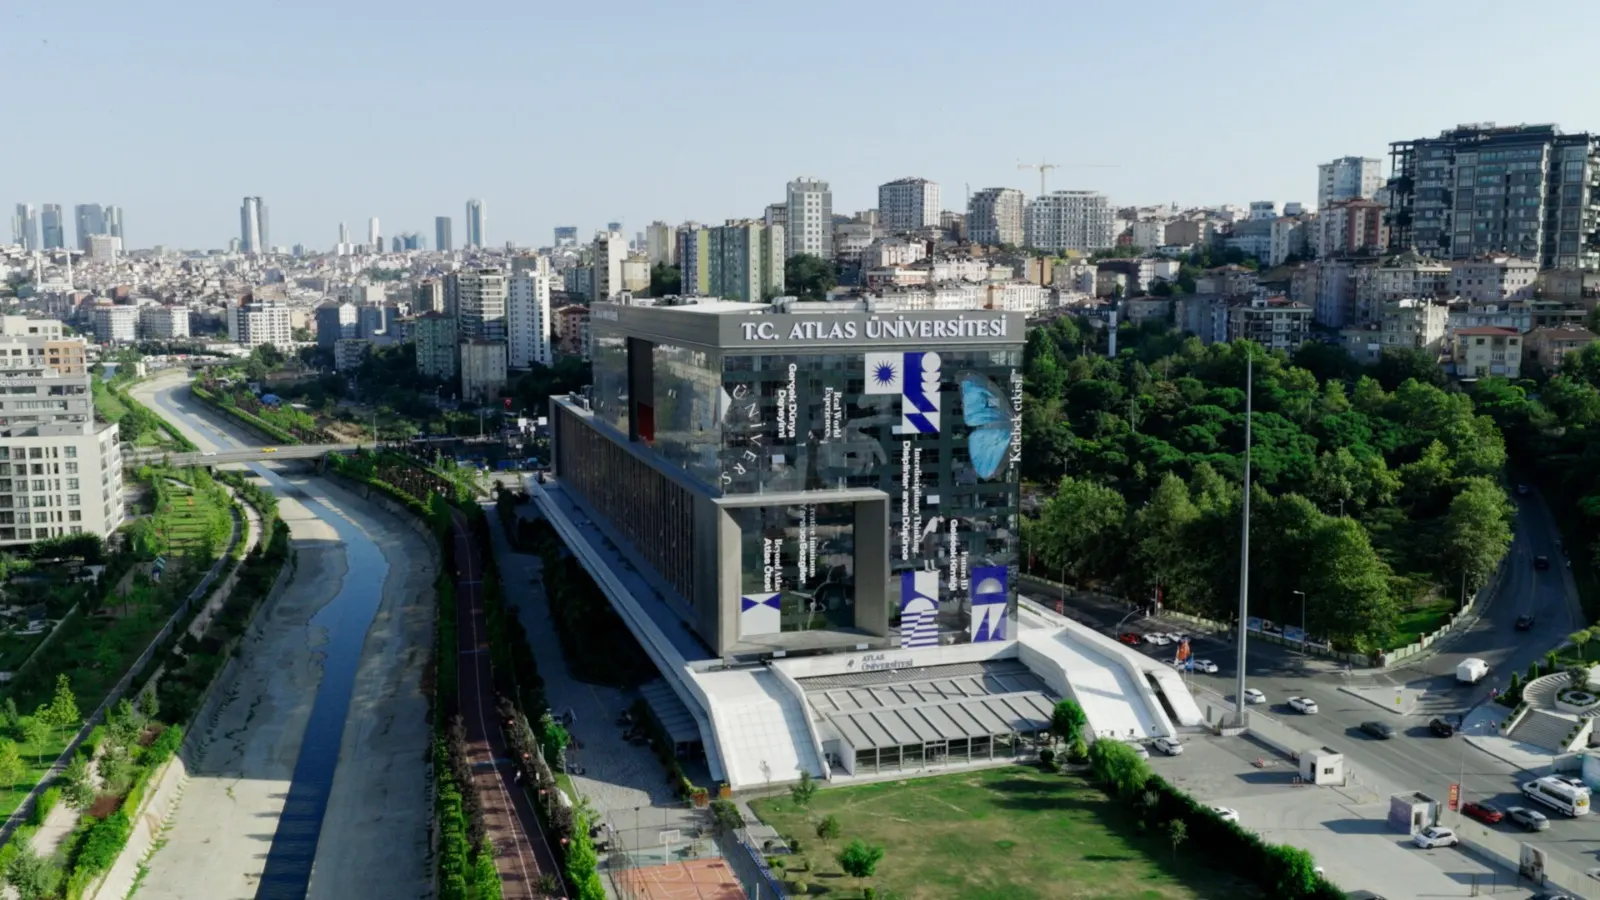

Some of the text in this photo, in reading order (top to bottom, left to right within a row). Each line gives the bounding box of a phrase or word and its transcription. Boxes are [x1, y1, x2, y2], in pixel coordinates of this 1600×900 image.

[741, 314, 1008, 340] T.C. ATLAS ÜNİVERSİTESİ
[862, 654, 885, 662] ATLAS
